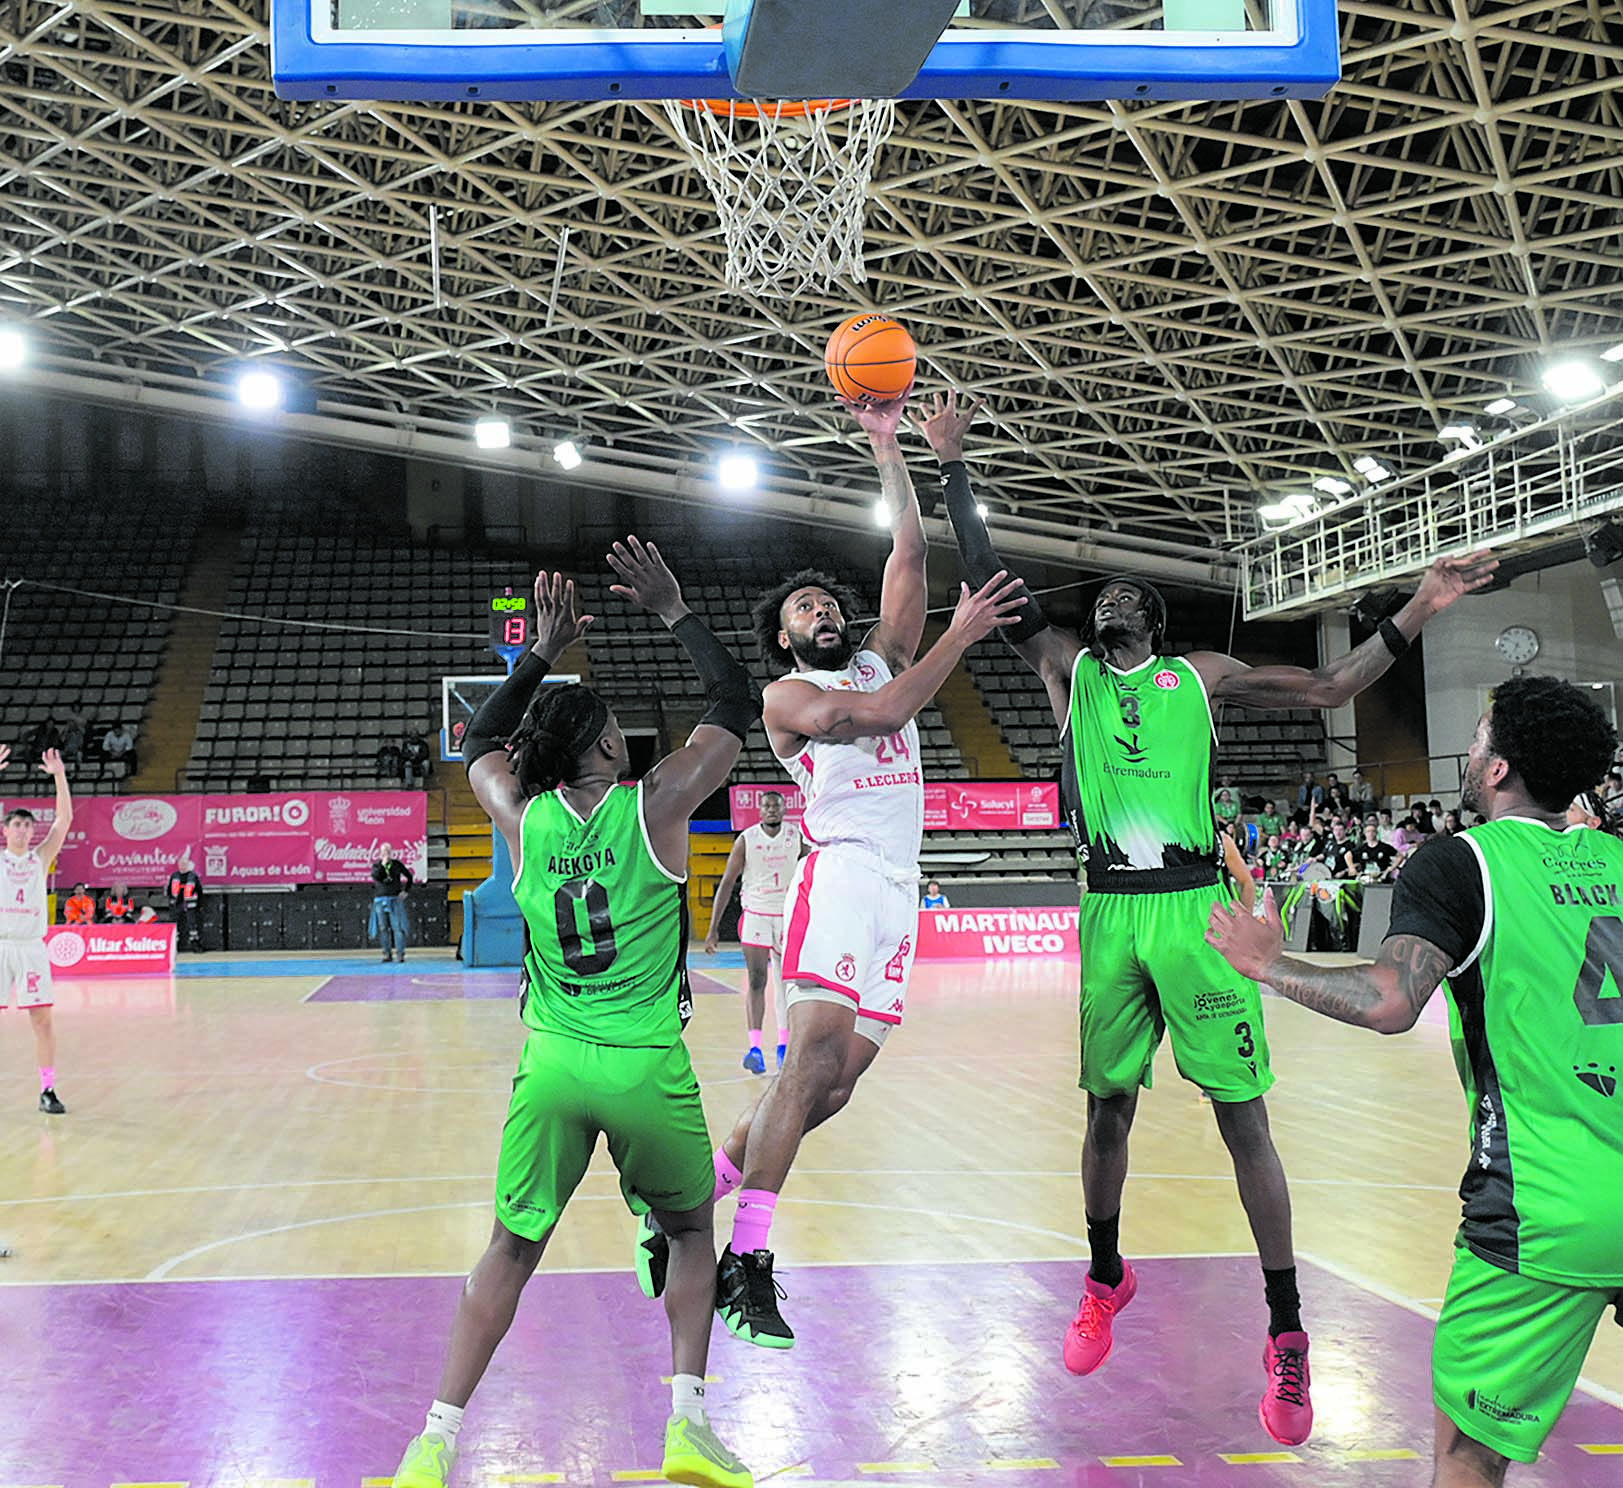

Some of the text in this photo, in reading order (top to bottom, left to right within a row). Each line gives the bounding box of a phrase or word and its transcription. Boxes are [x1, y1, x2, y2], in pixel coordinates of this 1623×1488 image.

[504, 616, 526, 645] 13
[1119, 696, 1141, 729] 3
[875, 731, 910, 764] 24
[205, 805, 280, 825] FUROR!
[93, 846, 177, 868] Cervantes
[231, 863, 311, 878] Aguas de León
[773, 872, 780, 887] 1
[16, 888, 25, 903] 4
[1549, 882, 1621, 907] BLACK
[554, 878, 618, 976] 0
[86, 936, 167, 953] Altar Suites
[983, 934, 1064, 953] IVECO
[1234, 1020, 1256, 1059] 3
